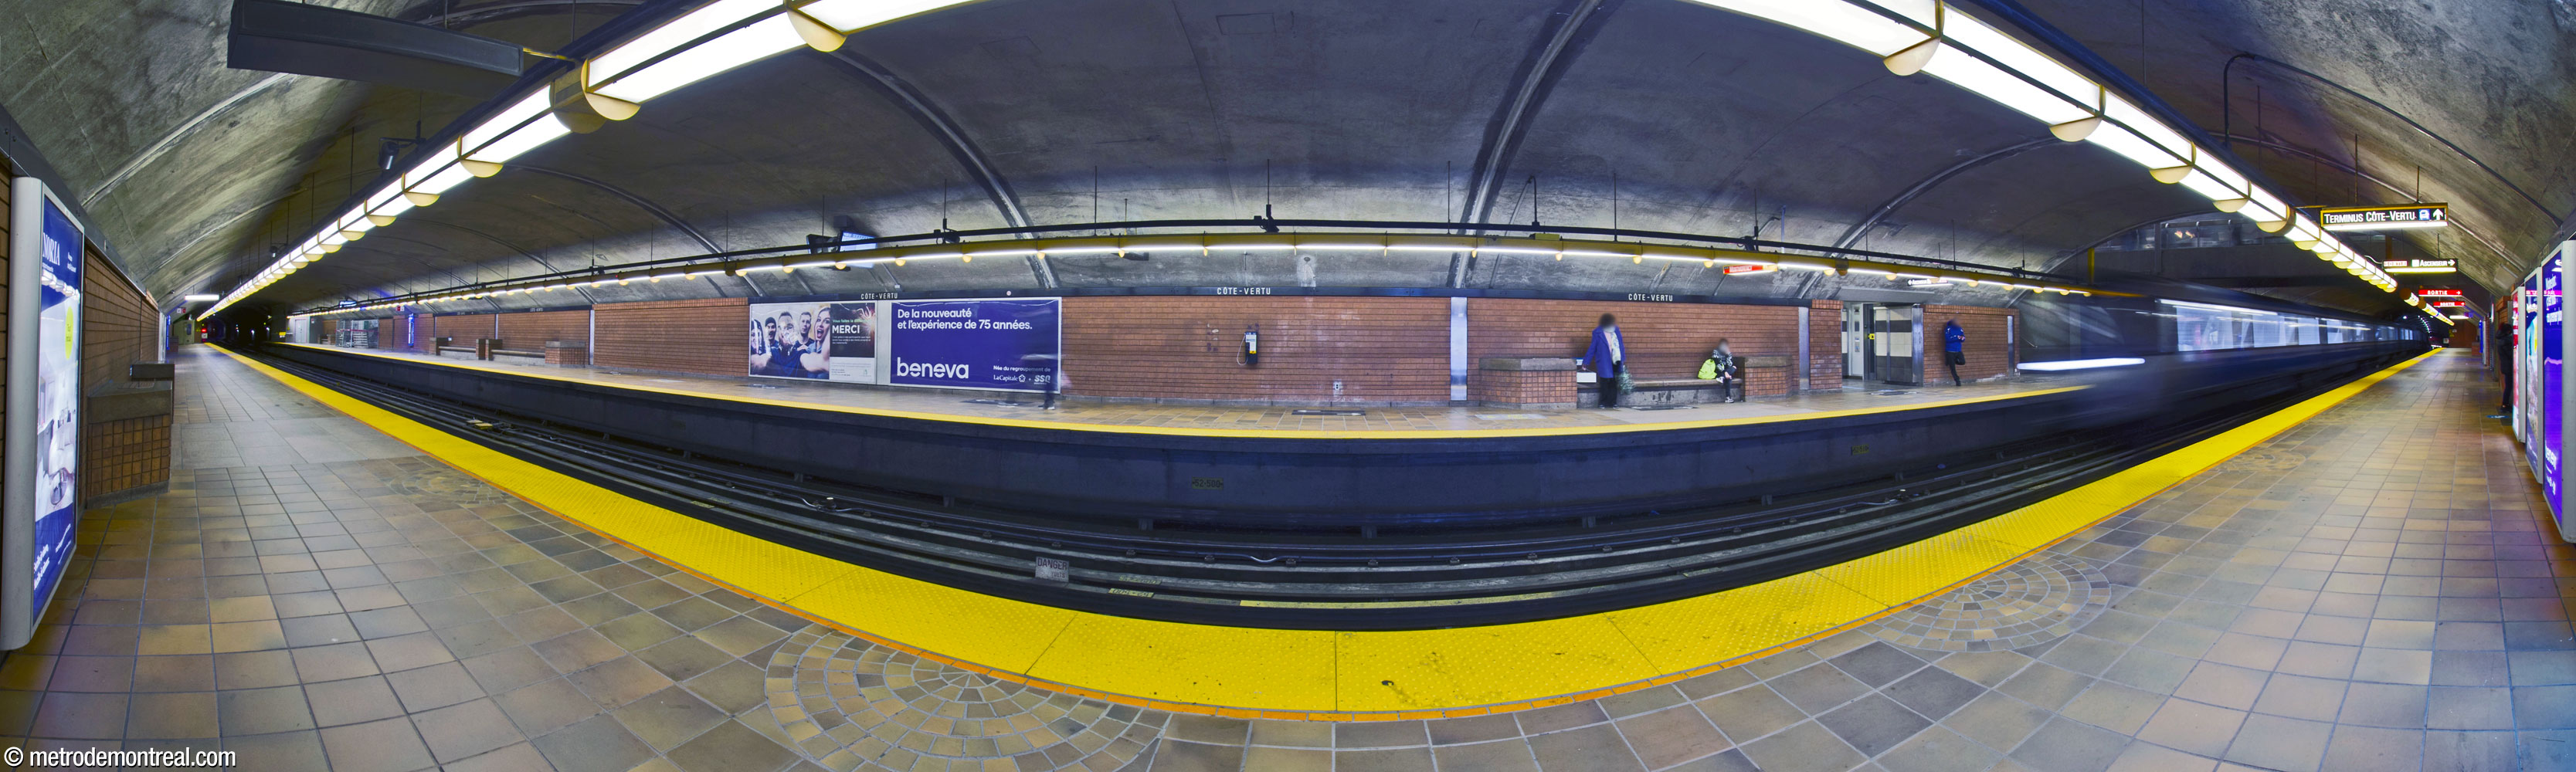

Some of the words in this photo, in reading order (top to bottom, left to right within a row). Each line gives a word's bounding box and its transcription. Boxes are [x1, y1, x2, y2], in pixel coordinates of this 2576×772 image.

[2324, 211, 2364, 224] TERMINUS
[2366, 210, 2415, 222] CÔTE-VERTU
[1217, 286, 1271, 295] CÔTE-VERTU
[1628, 293, 1674, 302] CÔTE-VERTU
[898, 309, 910, 318] De
[911, 309, 920, 318] la
[921, 308, 972, 318] nouveauté
[832, 325, 860, 334] MERCI
[898, 320, 907, 330] et
[908, 320, 962, 331] l'expérience
[964, 320, 977, 330] de
[979, 320, 991, 330] 75
[993, 320, 1033, 330] années.
[897, 357, 969, 379] beneva
[1037, 557, 1067, 571] DANGER
